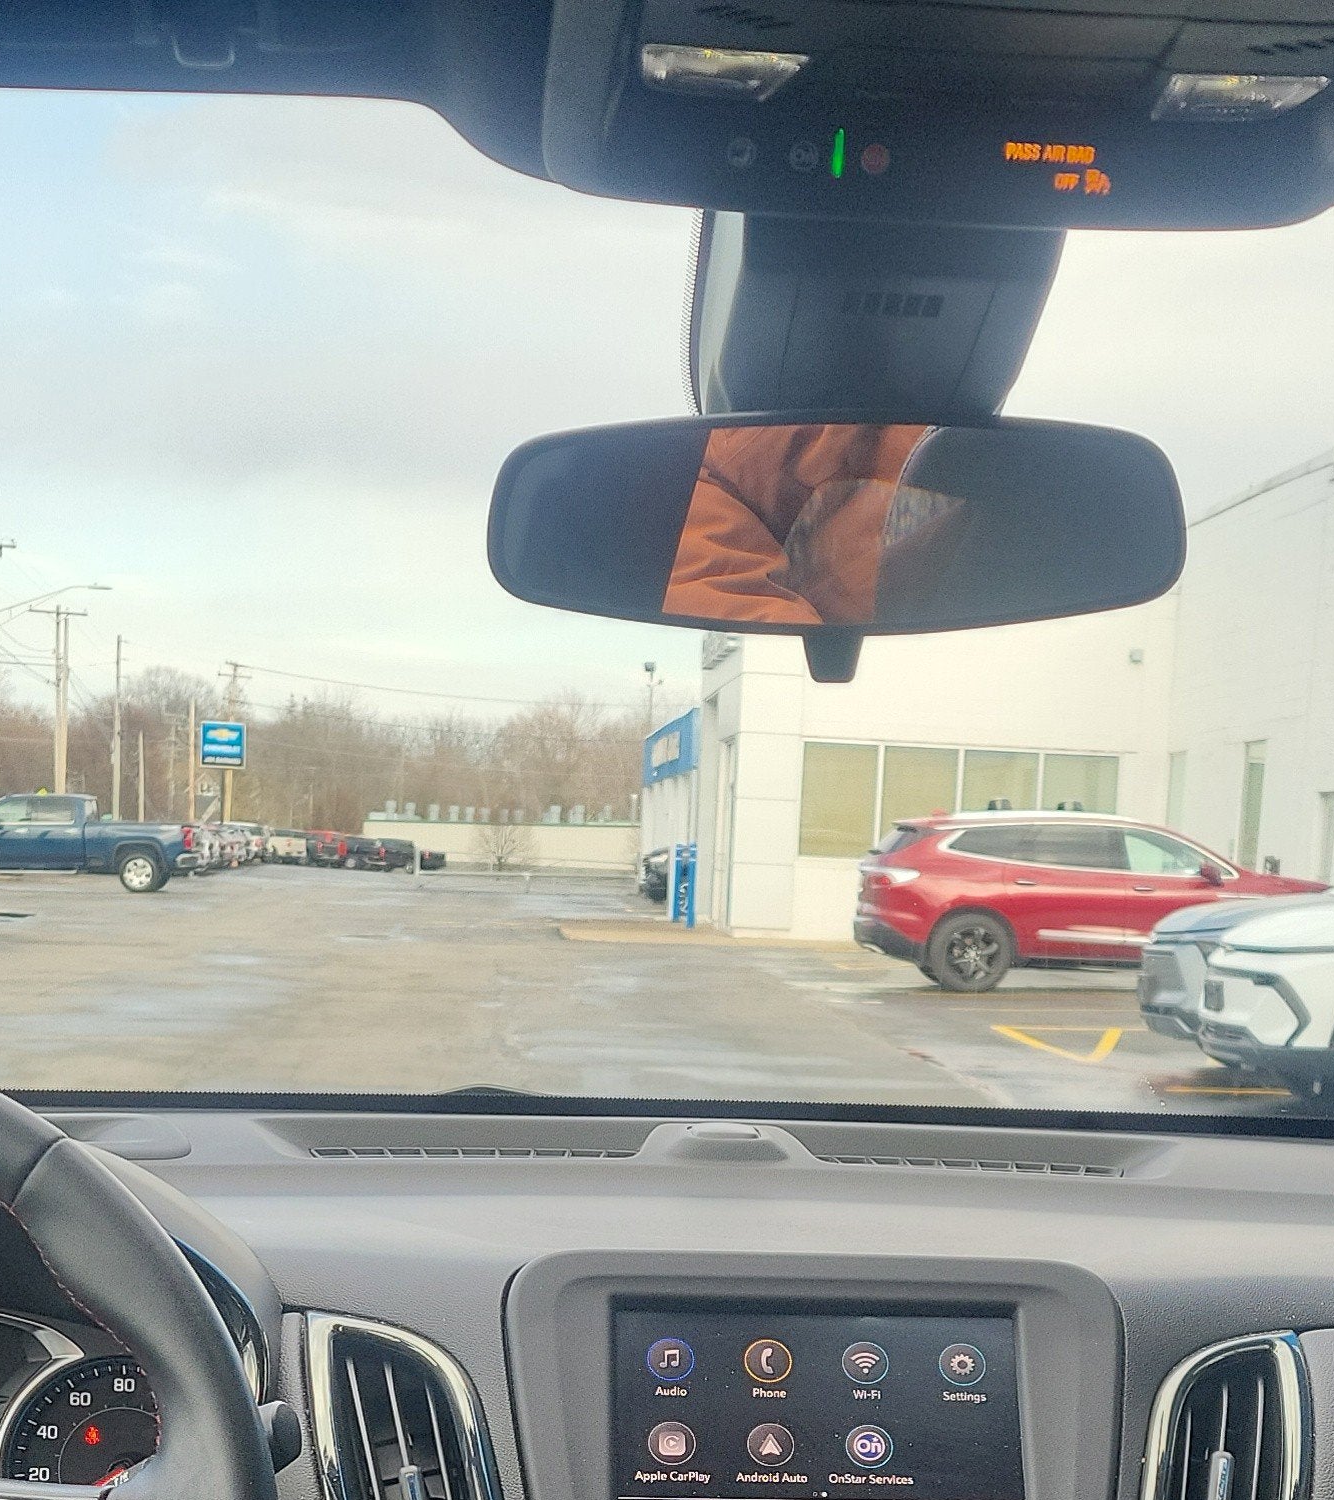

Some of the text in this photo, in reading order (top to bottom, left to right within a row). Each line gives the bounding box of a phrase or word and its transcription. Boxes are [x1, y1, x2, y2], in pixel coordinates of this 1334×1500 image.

[1005, 141, 1041, 161] PASS
[113, 1377, 136, 1392] 80
[655, 1385, 687, 1398] Audio
[69, 1391, 91, 1407] 60
[752, 1387, 787, 1399] Phone
[853, 1389, 881, 1400] Wi-Fi
[943, 1391, 987, 1404] Settings
[36, 1425, 58, 1440] 40
[28, 1467, 50, 1483] 20
[635, 1470, 711, 1485] Apple CarPlay
[736, 1471, 808, 1484] Android Auto
[829, 1474, 914, 1486] OnStar Services
